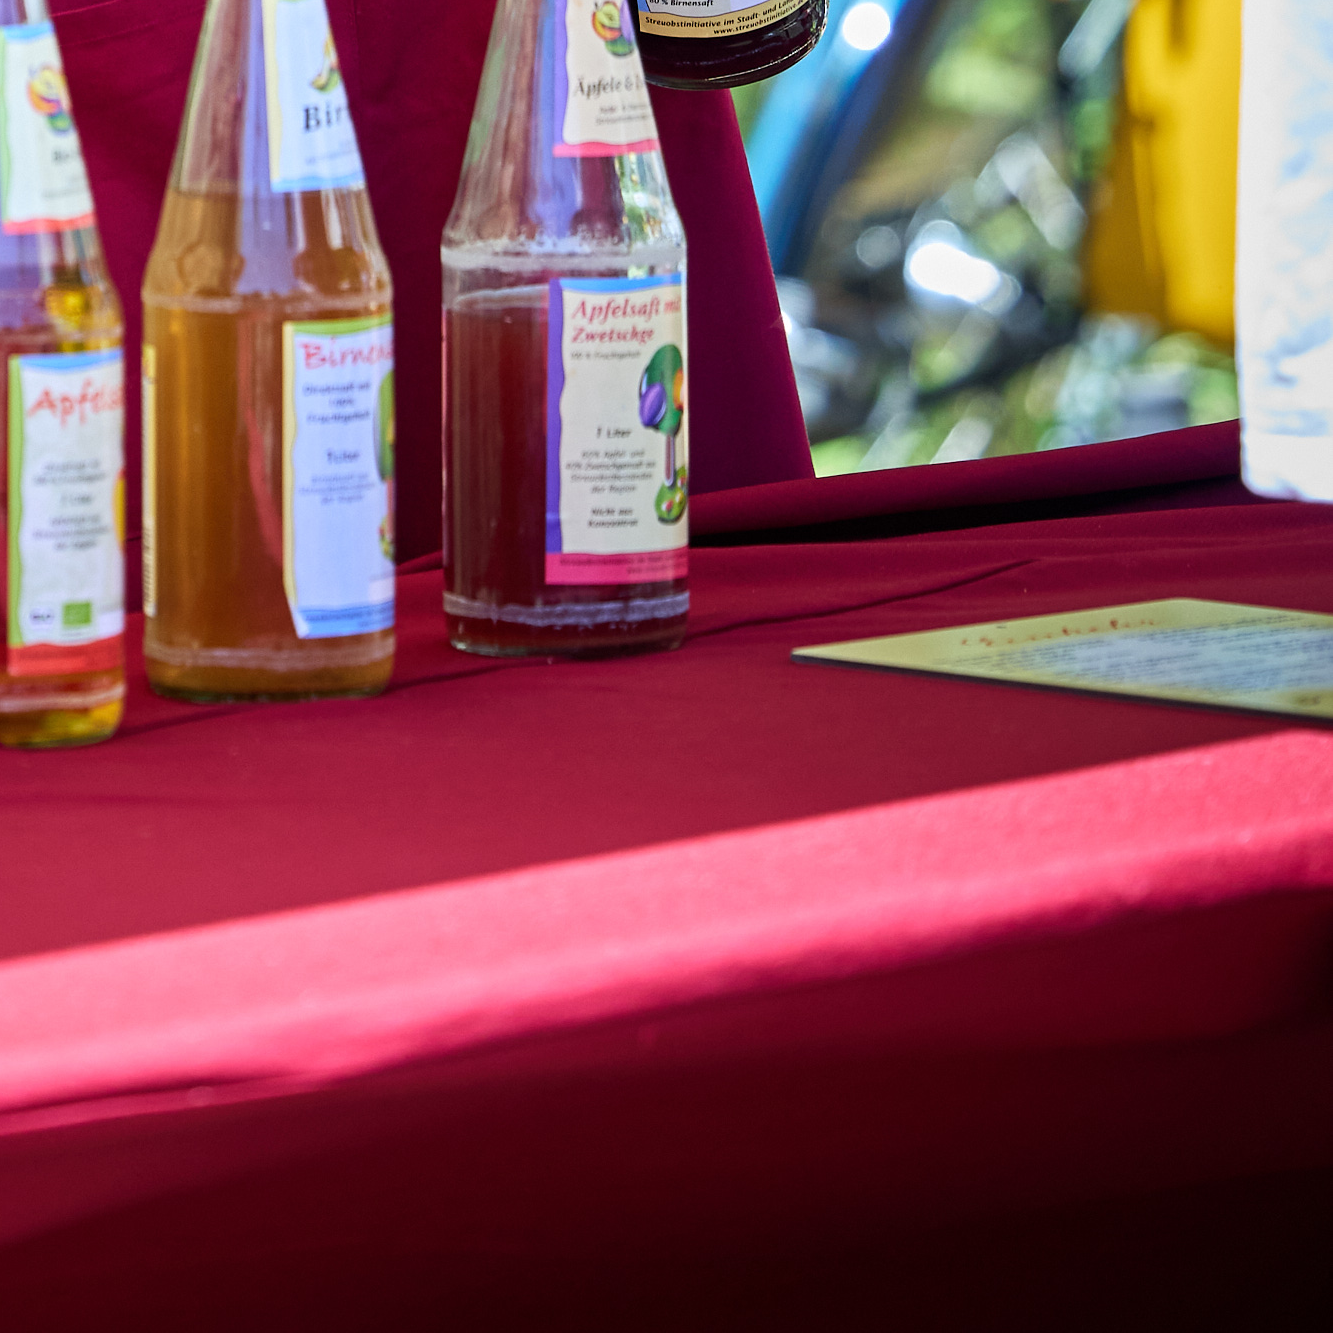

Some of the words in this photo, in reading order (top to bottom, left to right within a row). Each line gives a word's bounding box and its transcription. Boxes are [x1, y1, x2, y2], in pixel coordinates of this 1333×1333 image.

[645, 15, 722, 29] Streuobstinitiative
[723, 18, 735, 26] im
[736, 12, 761, 24] Stadt-
[762, 5, 777, 16] und
[571, 295, 660, 325] Apfelsaft
